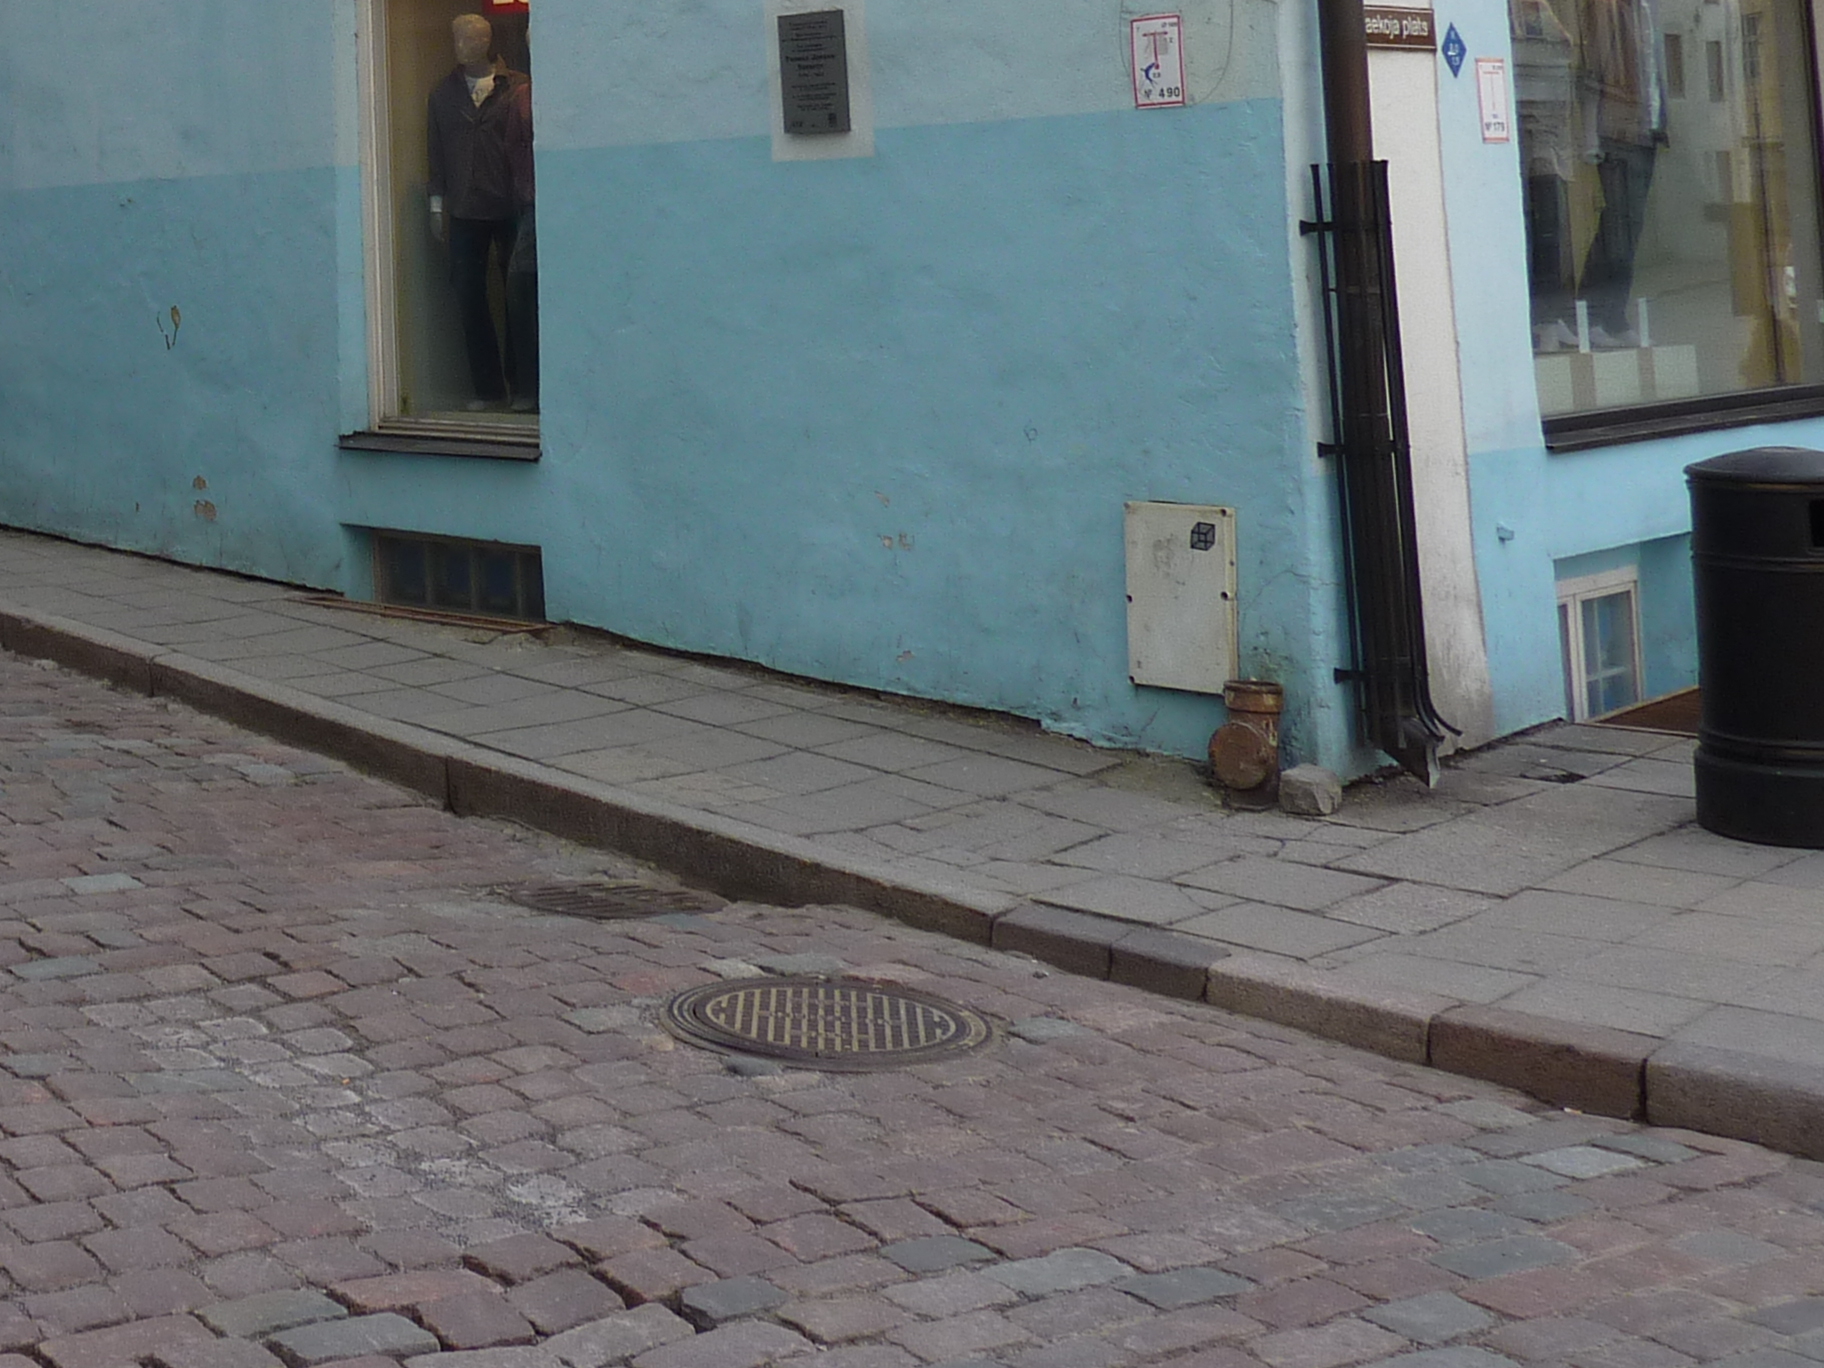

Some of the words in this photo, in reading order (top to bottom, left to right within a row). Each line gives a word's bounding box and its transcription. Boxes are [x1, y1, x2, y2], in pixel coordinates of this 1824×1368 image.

[1365, 14, 1400, 39] aekoja
[1402, 15, 1429, 39] plats
[1158, 86, 1180, 99] 490
